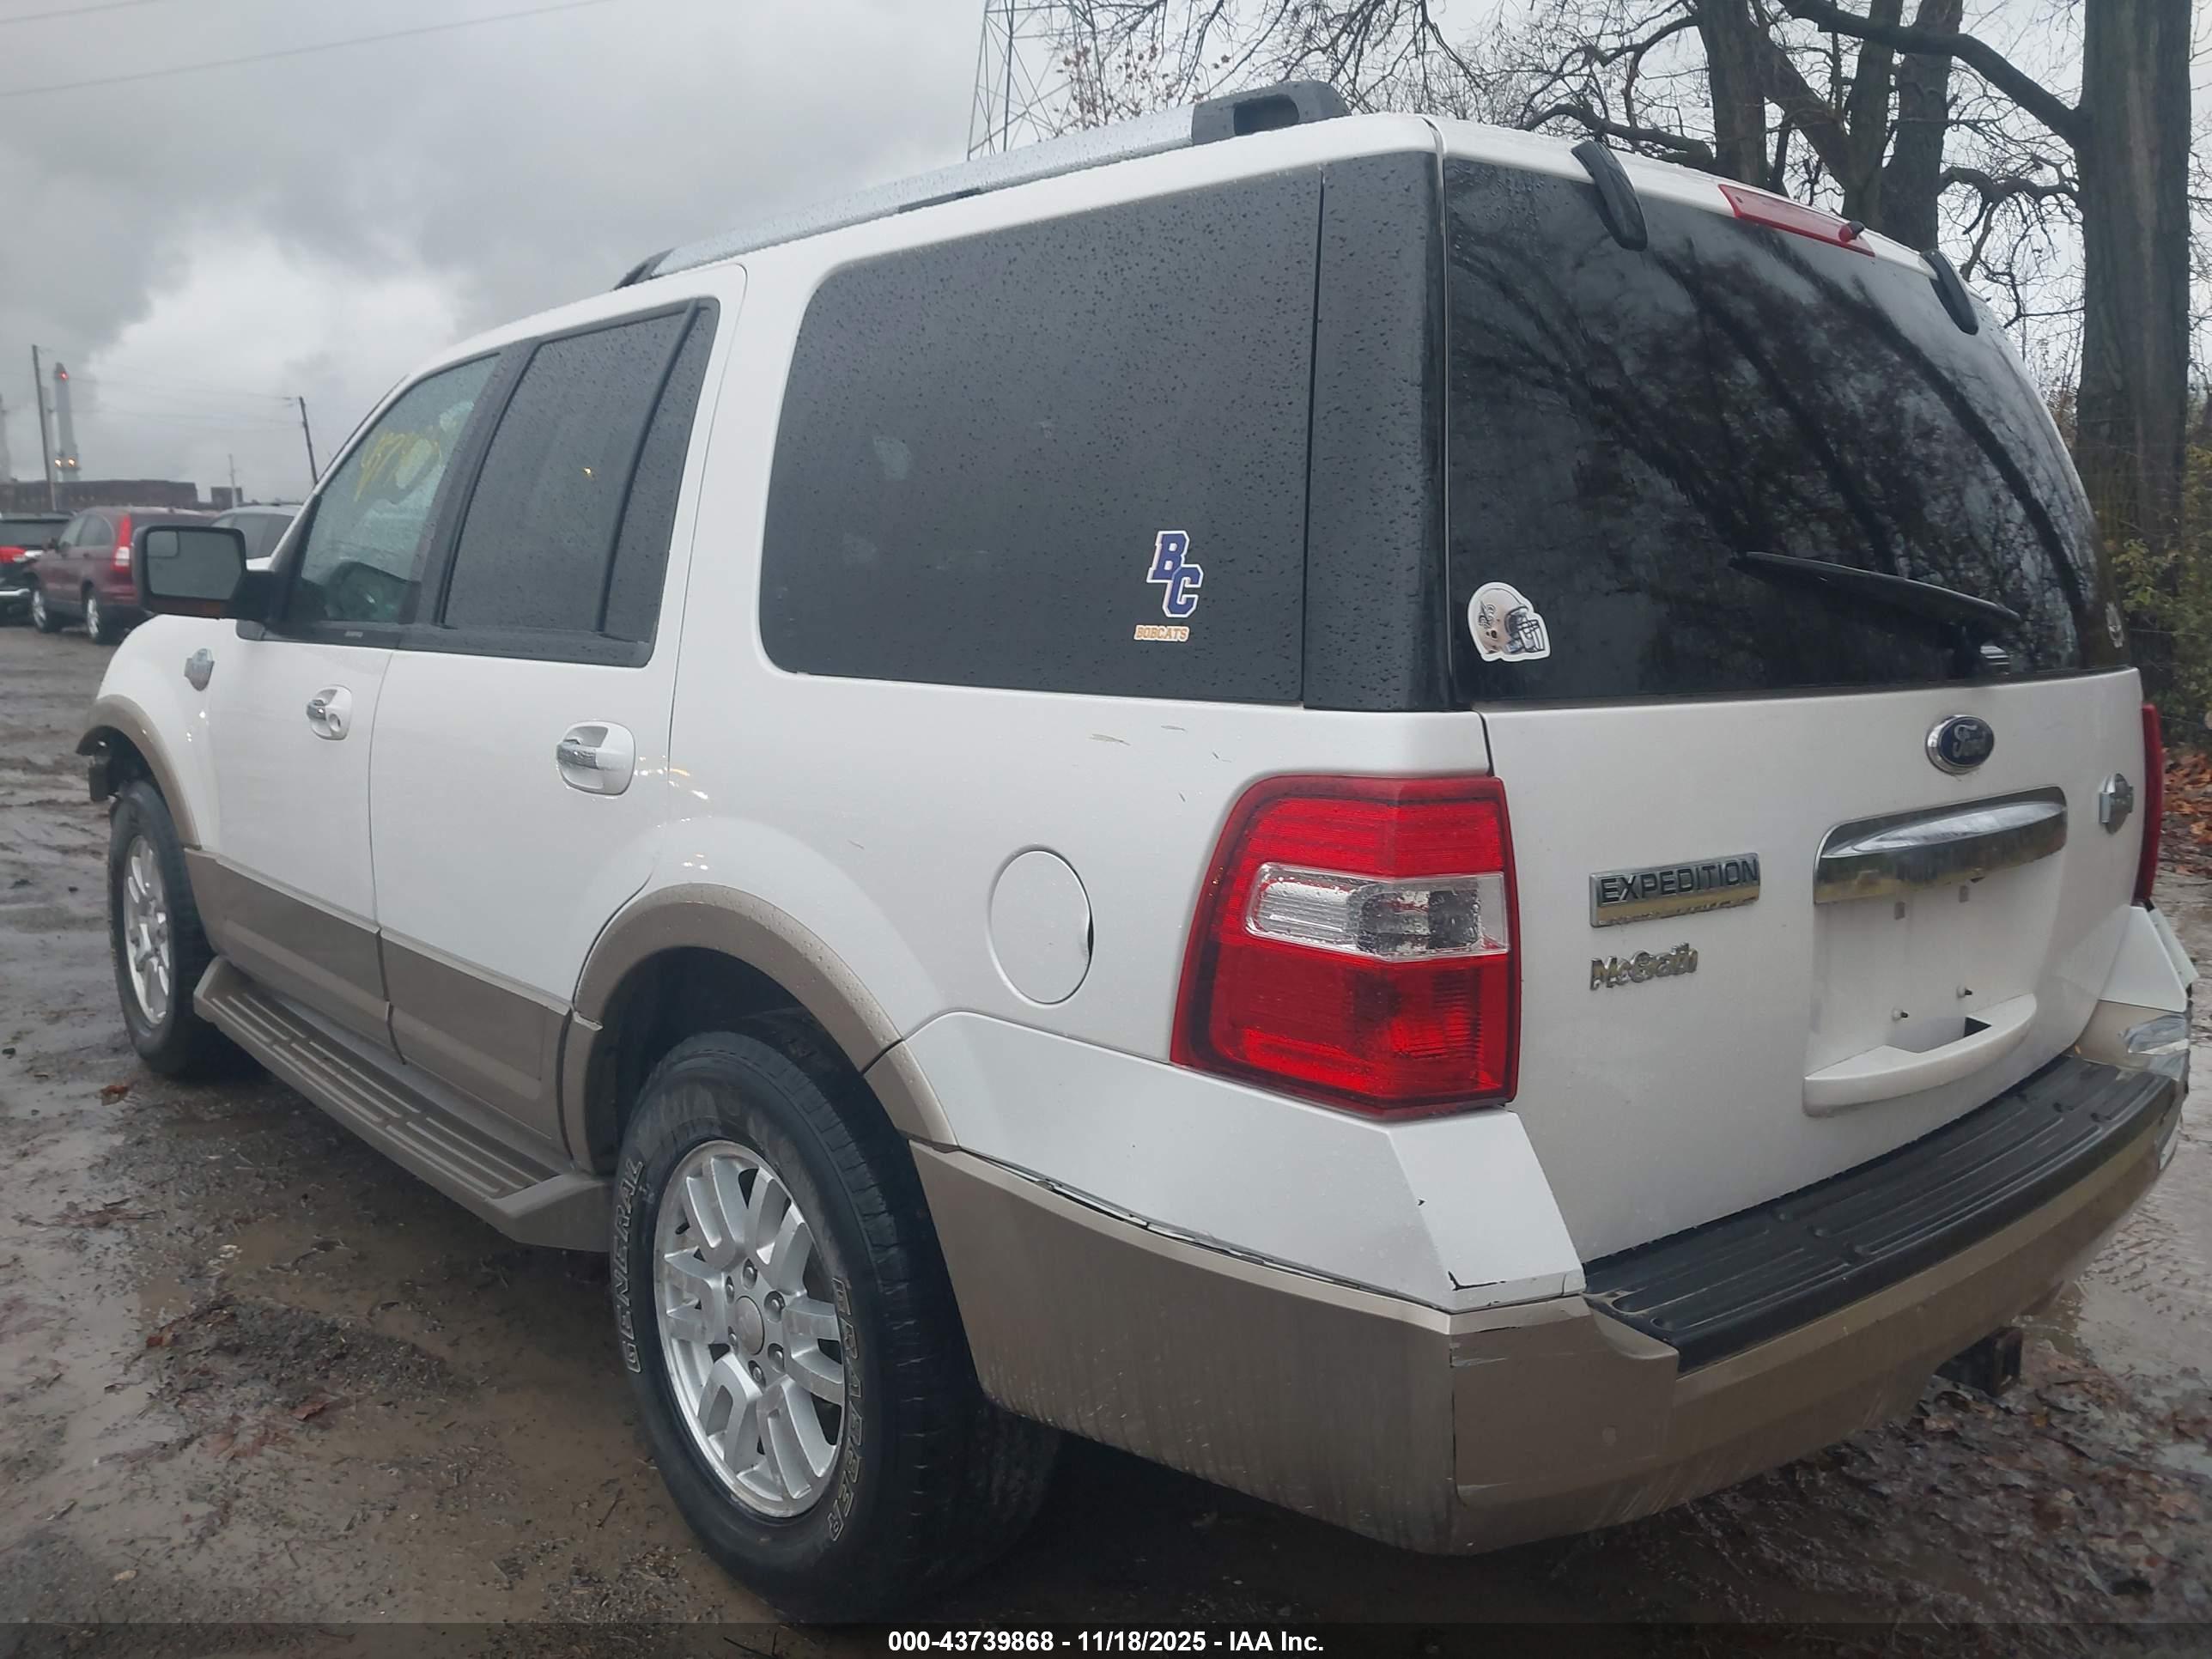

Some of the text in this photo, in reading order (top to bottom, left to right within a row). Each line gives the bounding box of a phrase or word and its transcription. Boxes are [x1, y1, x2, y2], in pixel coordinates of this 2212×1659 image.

[1134, 625, 1189, 641] BOBCATS
[1601, 857, 1759, 903] EXPEDITION
[613, 1158, 643, 1374] GENERAL
[828, 1277, 862, 1542] GRABBER
